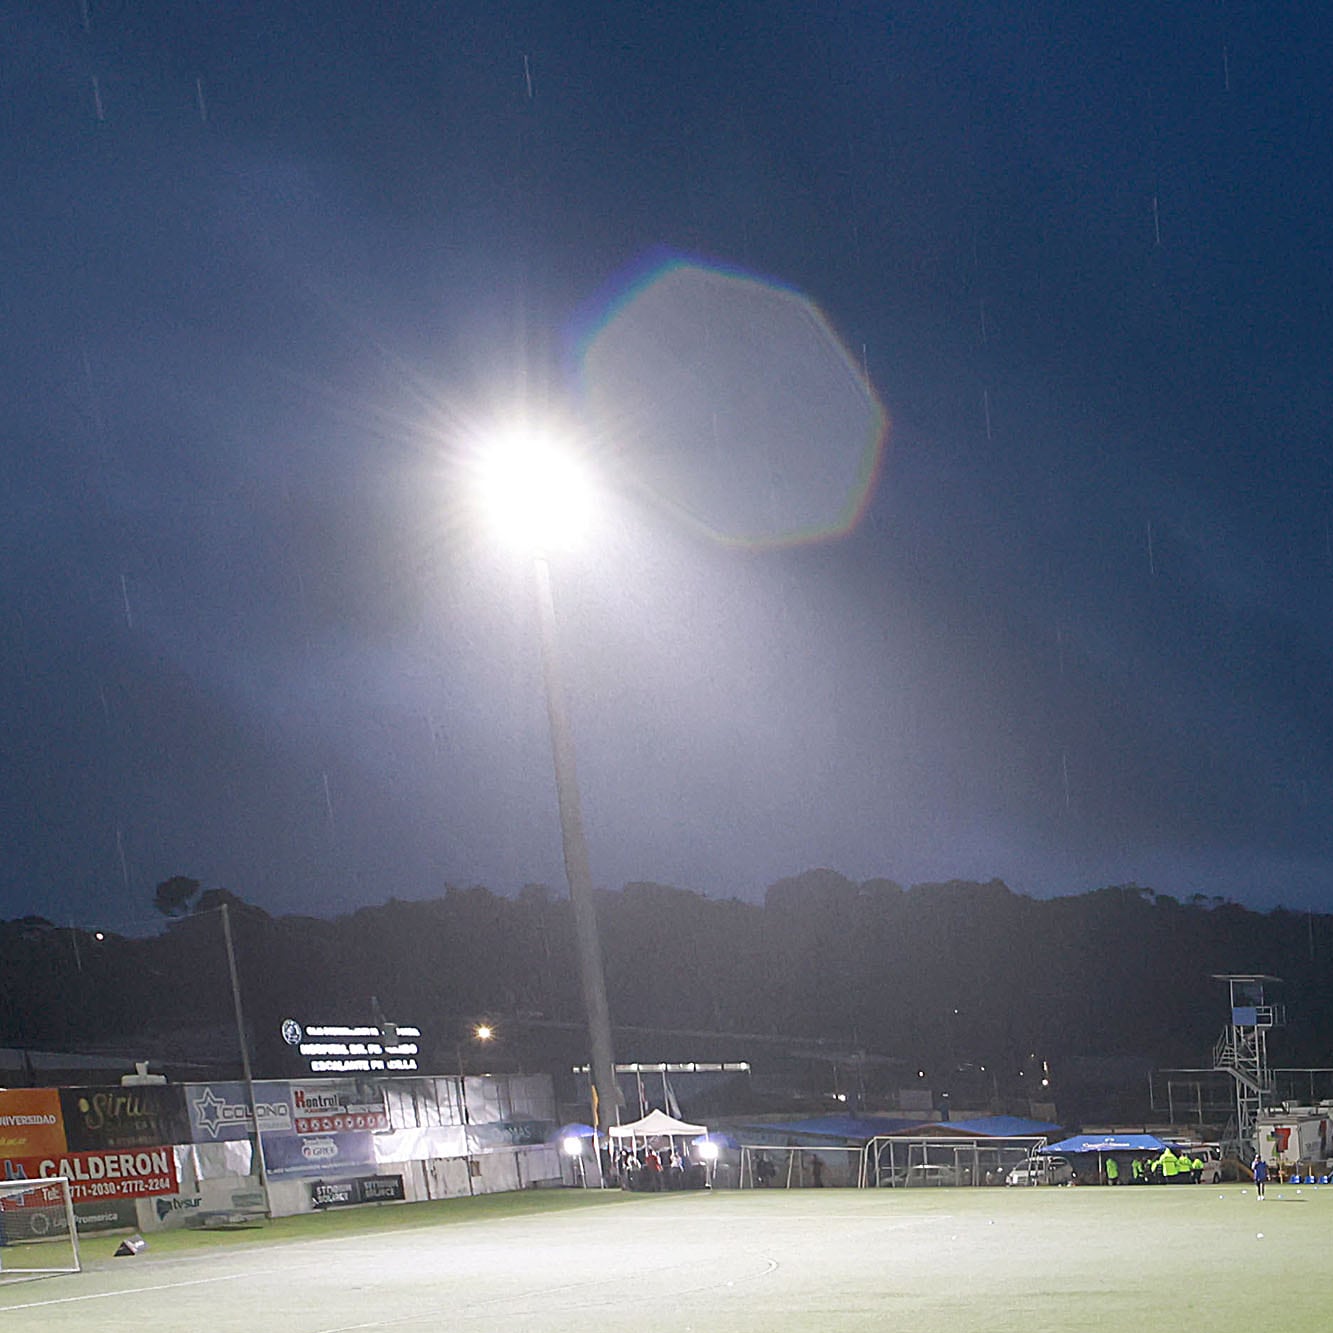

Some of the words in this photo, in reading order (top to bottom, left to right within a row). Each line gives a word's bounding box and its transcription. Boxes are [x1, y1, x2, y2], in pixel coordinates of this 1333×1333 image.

[221, 1102, 289, 1120] COLONO
[0, 1114, 57, 1127] NIVERSIDAD
[39, 1152, 169, 1181] CALDERON
[69, 1183, 116, 1198] 771-2030
